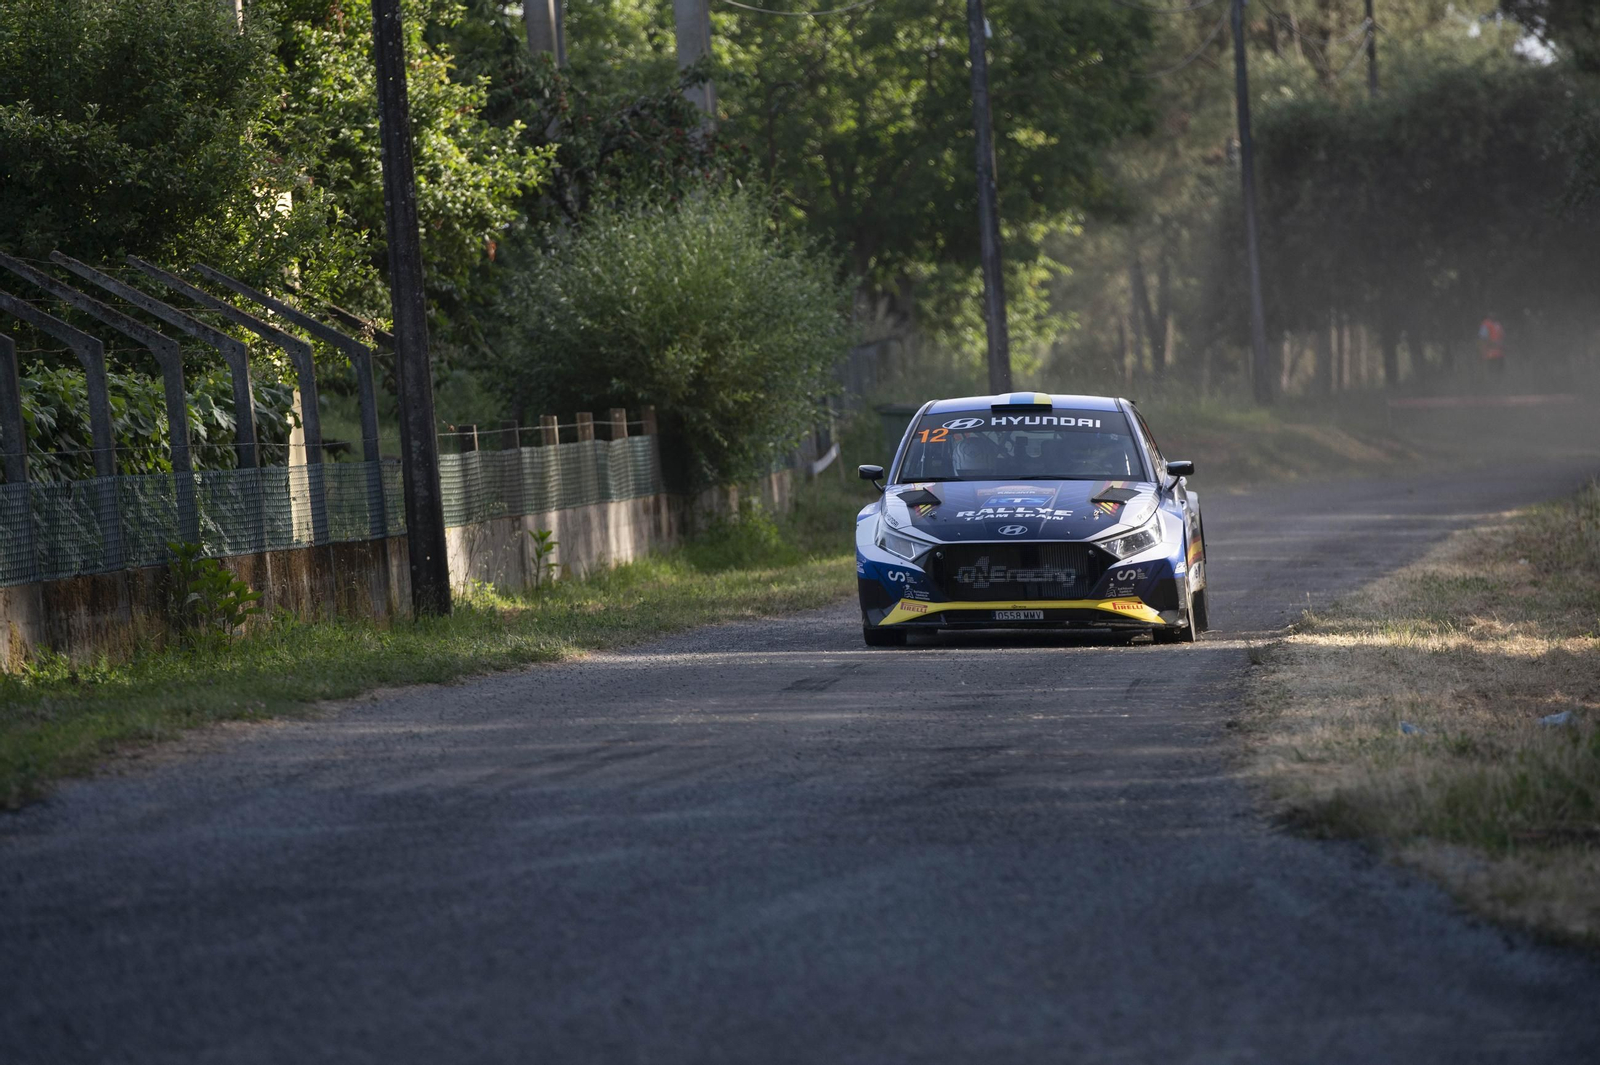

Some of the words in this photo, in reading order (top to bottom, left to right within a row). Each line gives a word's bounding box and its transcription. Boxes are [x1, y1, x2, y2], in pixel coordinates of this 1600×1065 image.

[991, 416, 1100, 428] HYUNDAI
[918, 429, 949, 443] 12
[956, 507, 1074, 518] RALLYE
[964, 513, 1009, 521] TEAM
[1014, 513, 1064, 521] SPAIN
[900, 602, 928, 613] PIRELLI
[1112, 601, 1144, 610] PIRELLI
[997, 611, 1021, 619] 0558
